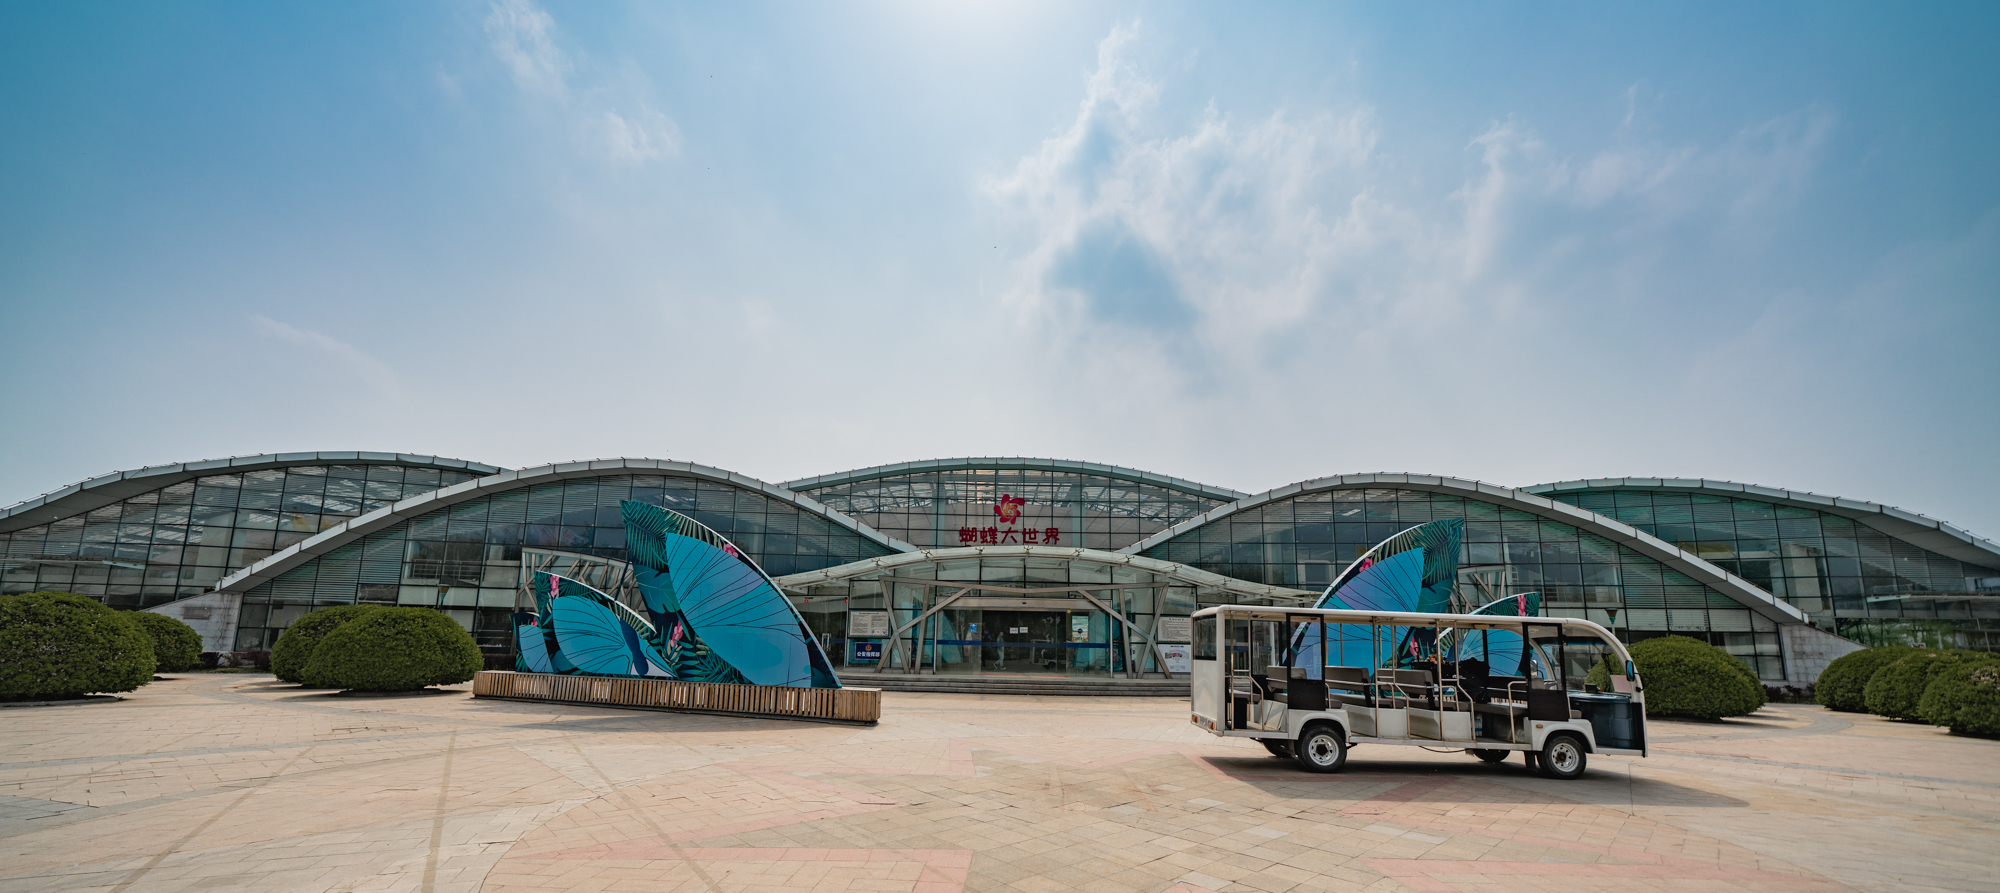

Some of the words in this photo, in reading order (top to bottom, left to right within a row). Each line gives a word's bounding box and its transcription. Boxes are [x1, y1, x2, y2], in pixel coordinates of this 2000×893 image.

[959, 526, 1060, 545] 蝴蝶大世界
